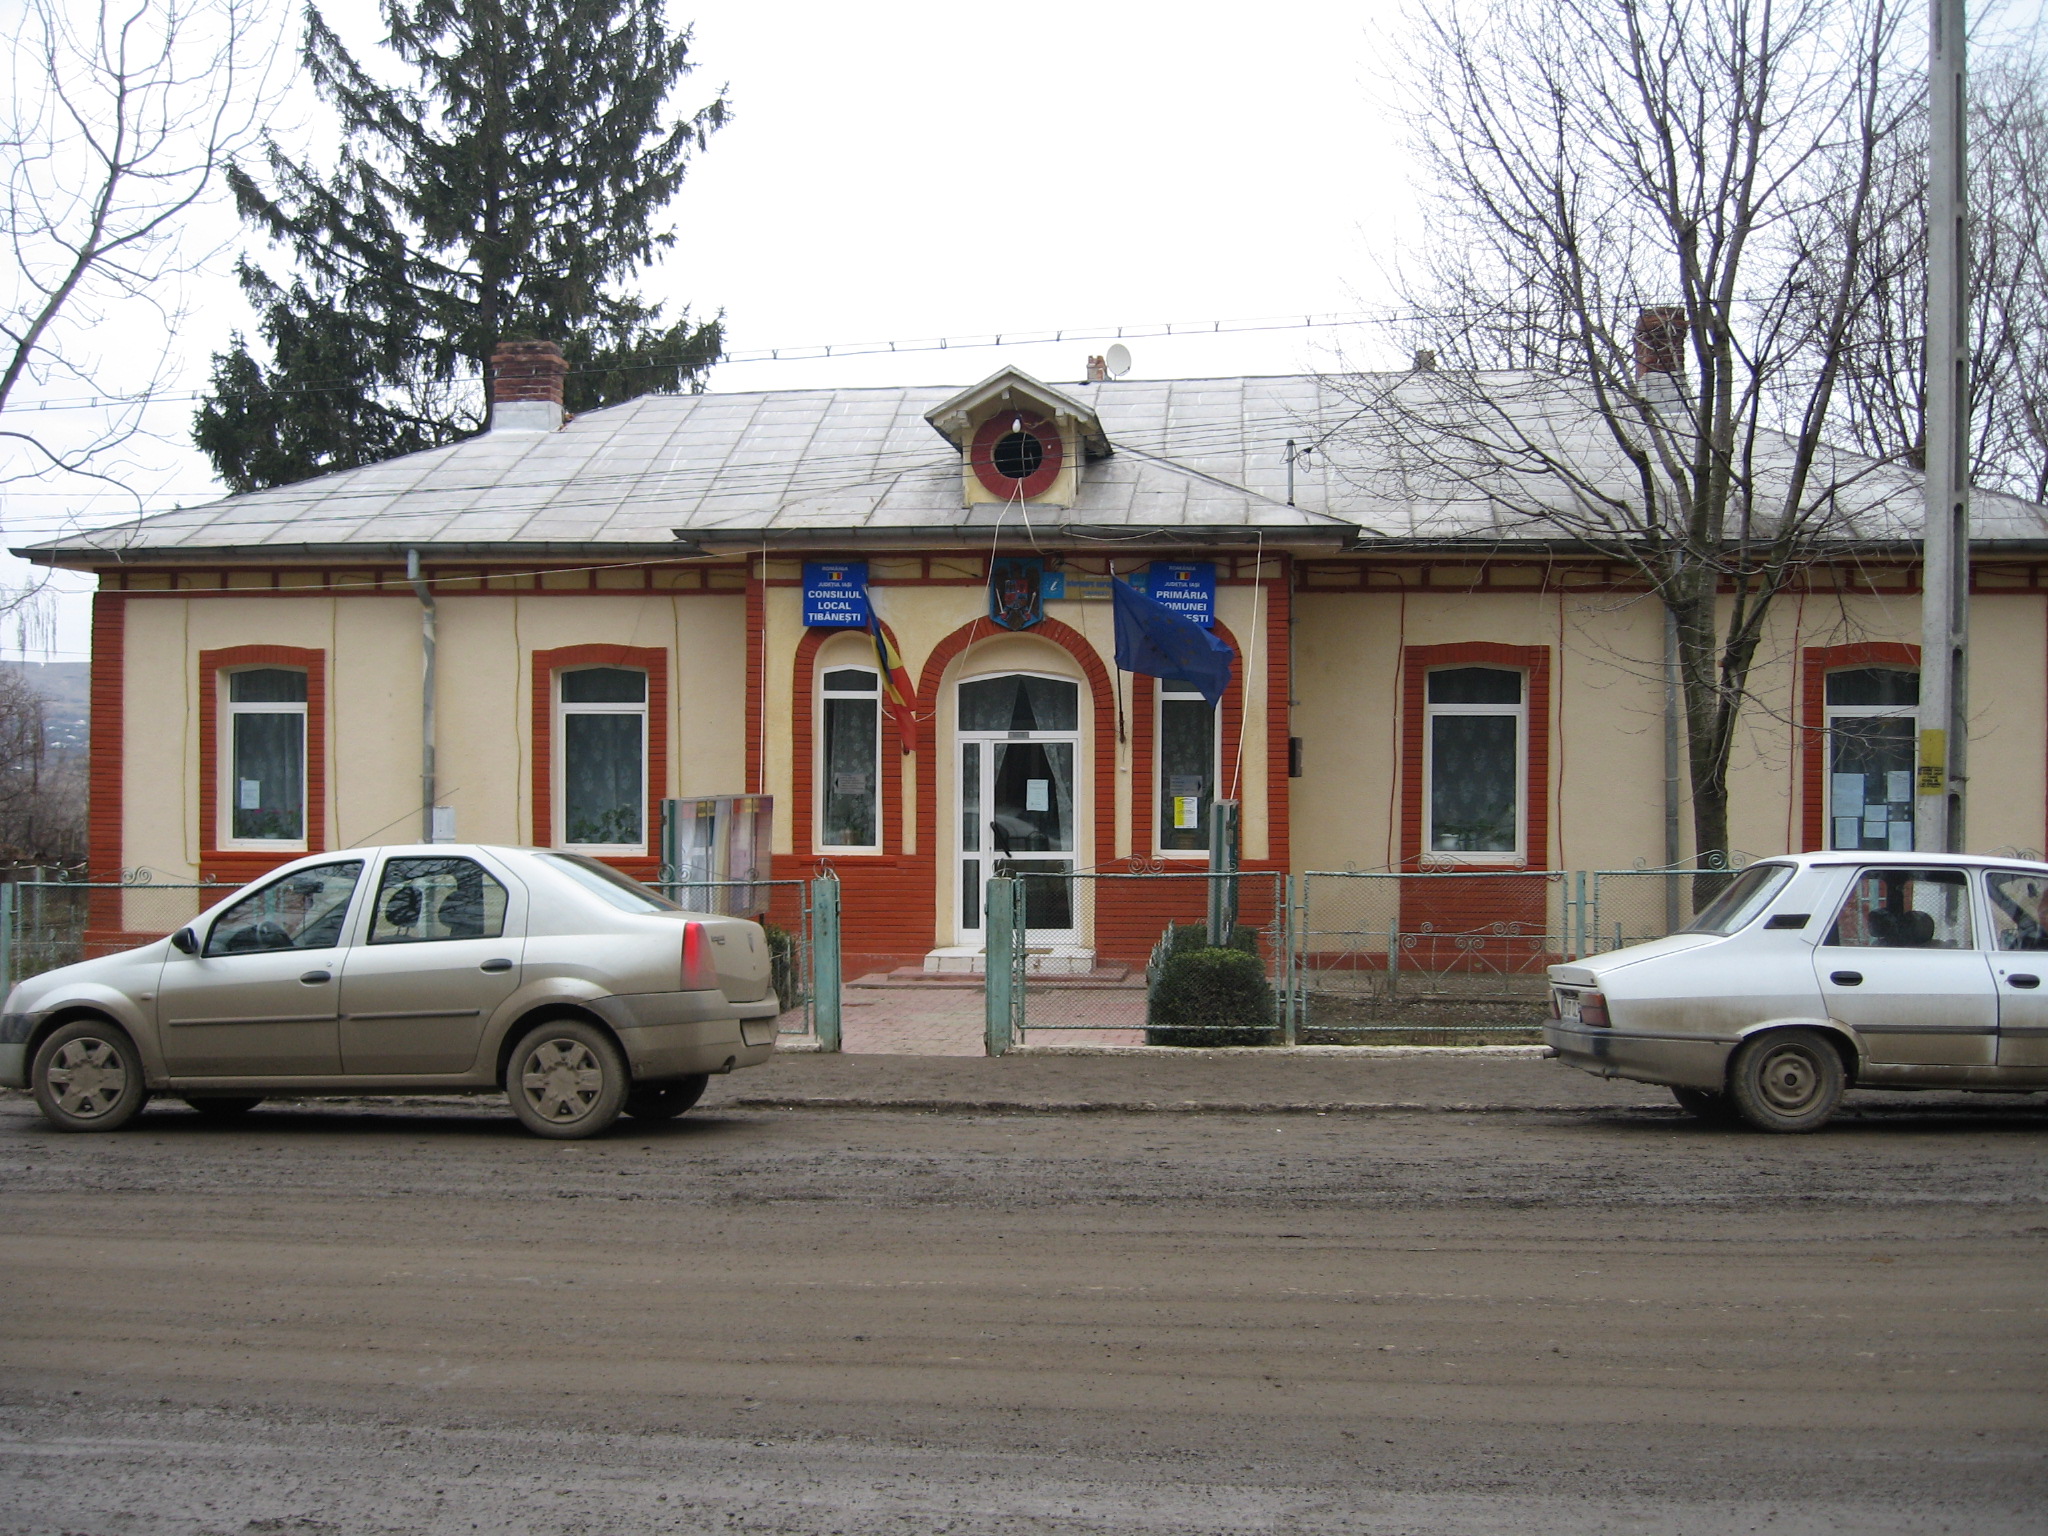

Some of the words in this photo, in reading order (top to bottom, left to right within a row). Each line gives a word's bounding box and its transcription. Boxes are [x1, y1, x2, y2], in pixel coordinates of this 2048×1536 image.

[808, 590, 862, 599] CONSILIUL
[818, 602, 852, 610] LOCAL
[1160, 602, 1207, 611] OMUNEI
